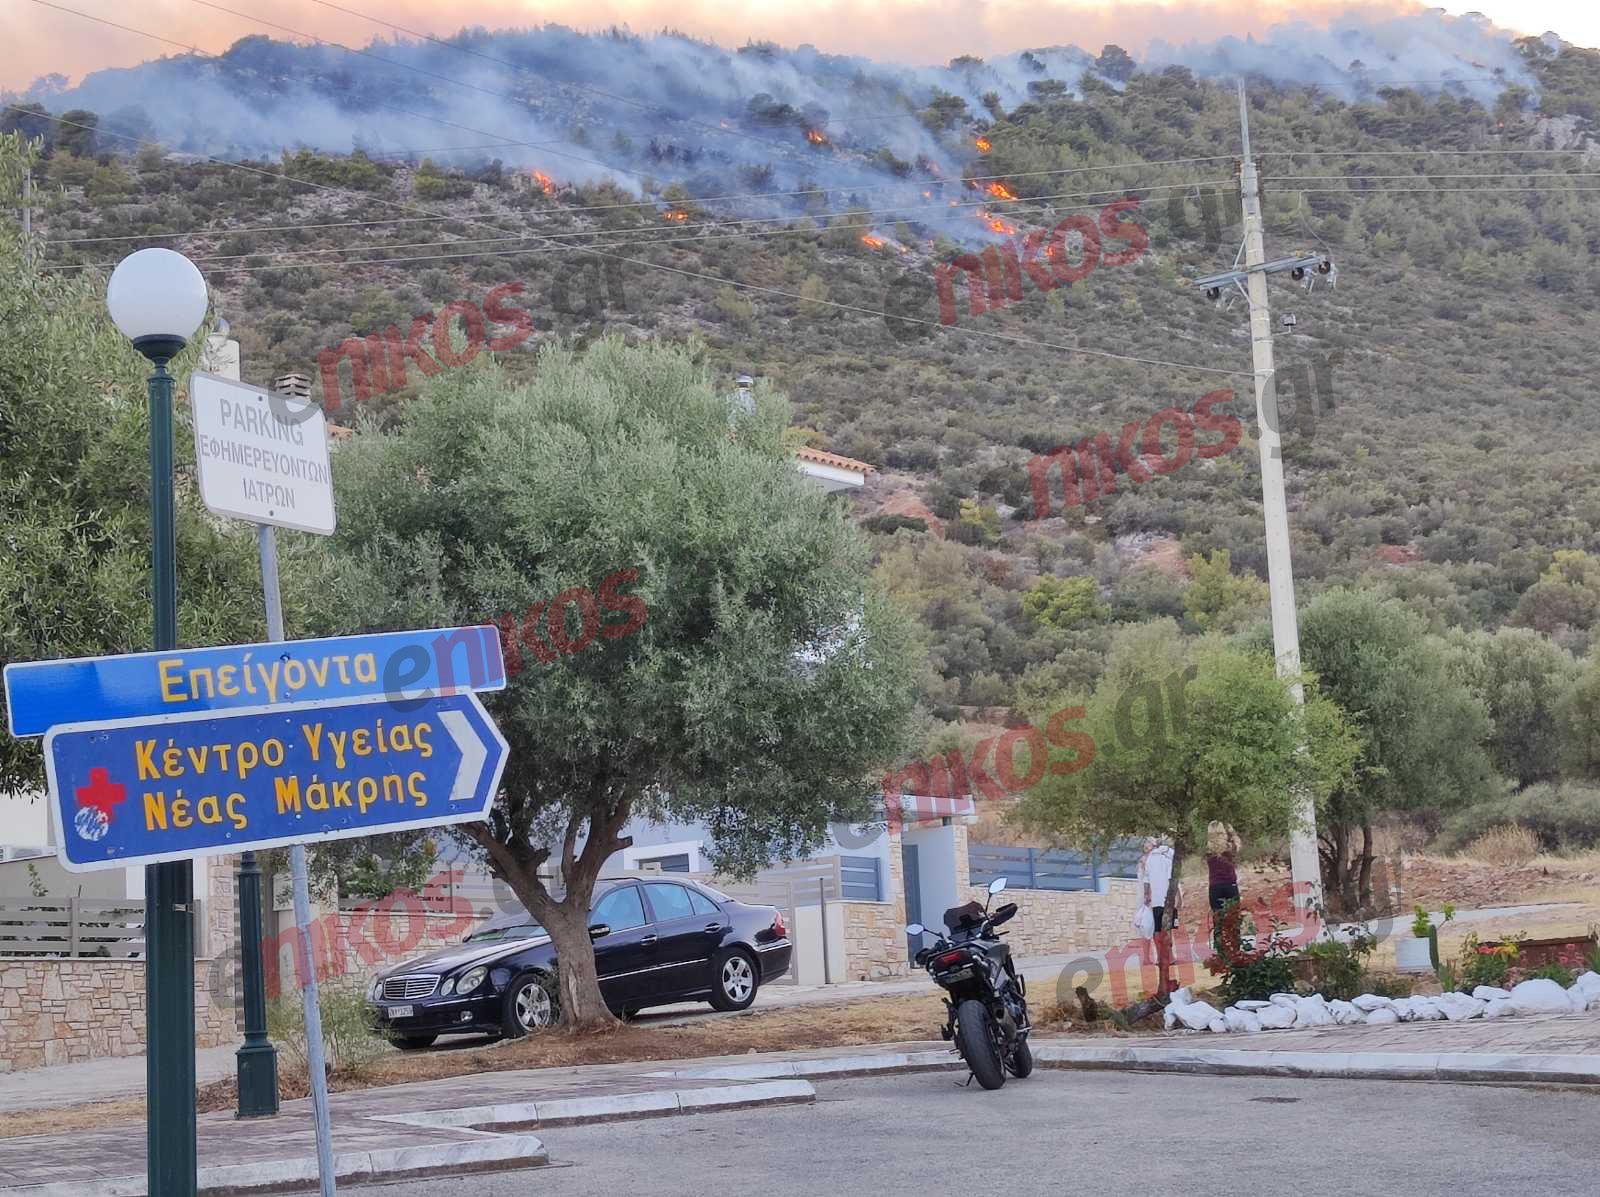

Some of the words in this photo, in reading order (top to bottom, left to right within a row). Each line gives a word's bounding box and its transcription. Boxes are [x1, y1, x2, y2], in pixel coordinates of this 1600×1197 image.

[219, 398, 304, 446] PARKING
[200, 434, 328, 485] ΕΦΗΜΕΡΕΥΟΝΤΩΝ
[243, 478, 296, 509] ΙΑΤΡΩΝ
[158, 653, 377, 703] Επείγοντα
[135, 737, 284, 780] Κέντρο
[302, 719, 432, 769] Υγείας
[143, 788, 248, 831] Νέας
[274, 771, 429, 814] Μάκρης
